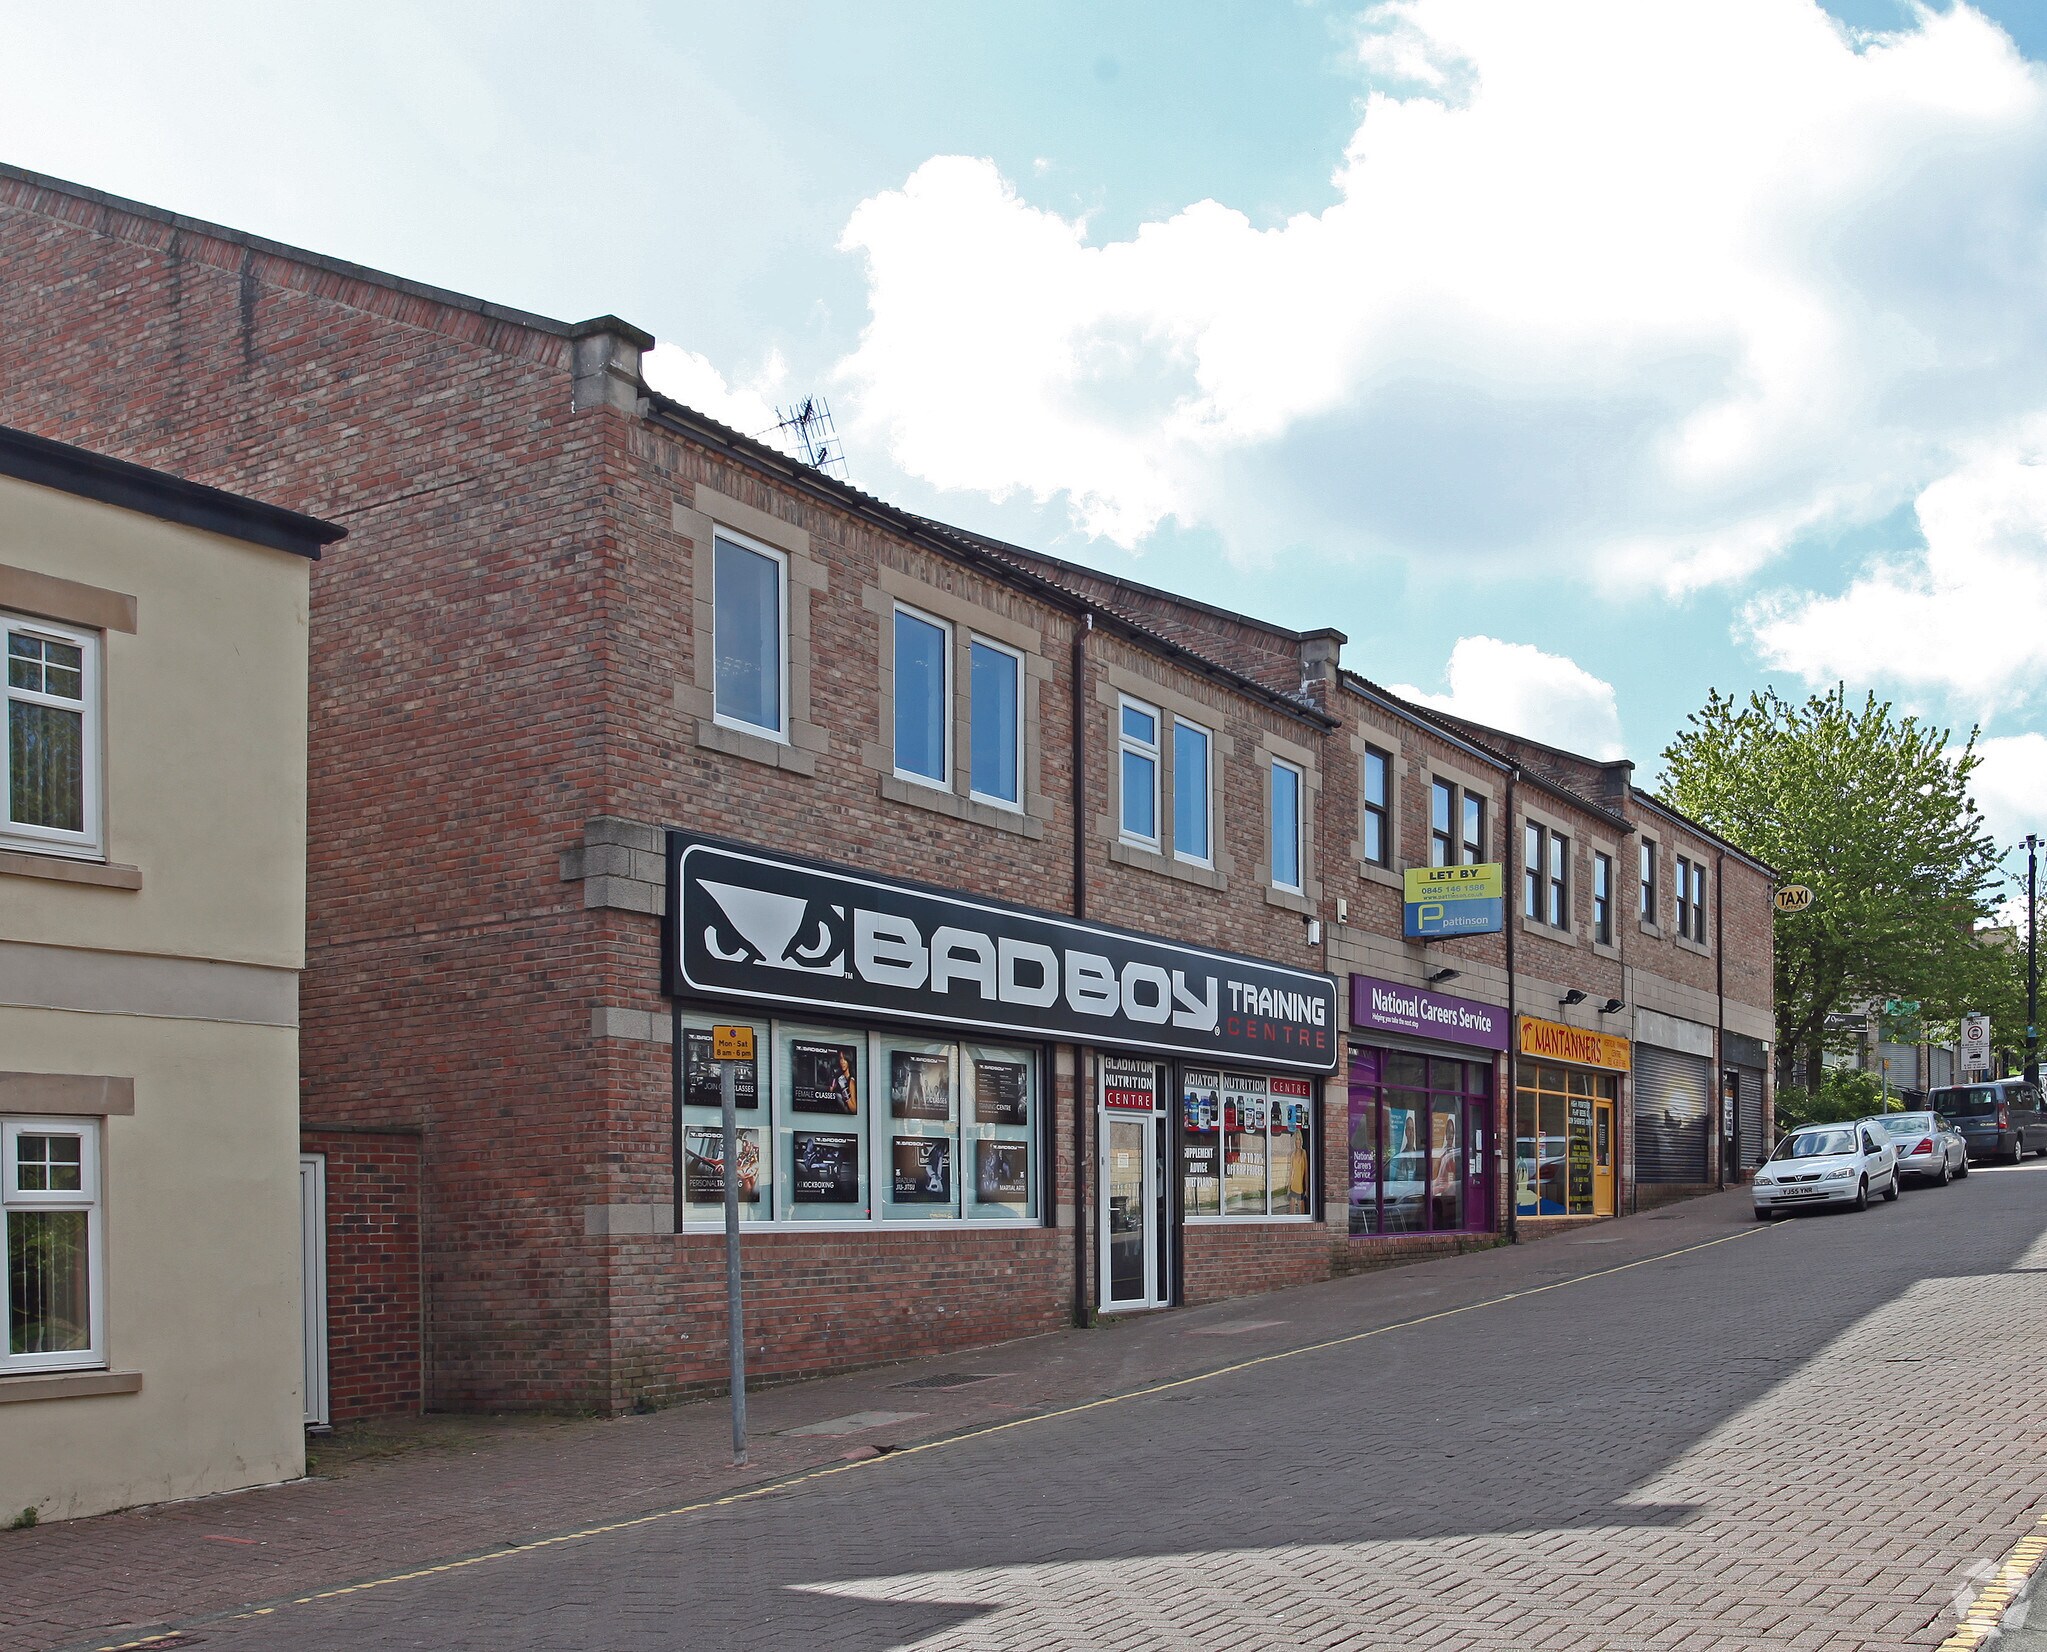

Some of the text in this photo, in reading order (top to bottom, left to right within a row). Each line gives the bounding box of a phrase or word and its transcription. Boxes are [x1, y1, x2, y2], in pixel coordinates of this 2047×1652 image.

[1430, 869, 1479, 880] LET BY
[1421, 886, 1443, 895] 0845
[1779, 890, 1808, 906] TAXI
[1443, 916, 1489, 928] pattinson
[1227, 980, 1325, 1027] TRAINING
[1372, 987, 1492, 1033] National Careers Service
[1372, 1012, 1385, 1023] Helping
[1227, 1016, 1325, 1049] CENTRE
[1534, 1025, 1602, 1064] MANTANNERS
[742, 1051, 751, 1059] pm
[1105, 1056, 1153, 1073] GLADIATOR
[1105, 1073, 1153, 1090] NUTRITION
[1184, 1072, 1306, 1095] ADIATOR NUTRITION CENTRE
[735, 1085, 754, 1093] LASSES
[795, 1089, 814, 1098] FEMALE
[814, 1091, 836, 1100] CLASSES
[1107, 1092, 1150, 1107] CENTRE
[1184, 1147, 1213, 1158] SUPPLEMENT
[1353, 1150, 1374, 1161] National
[1190, 1162, 1208, 1173] ADVICE
[1353, 1160, 1371, 1170] Careers
[1354, 1169, 1371, 1179] Service
